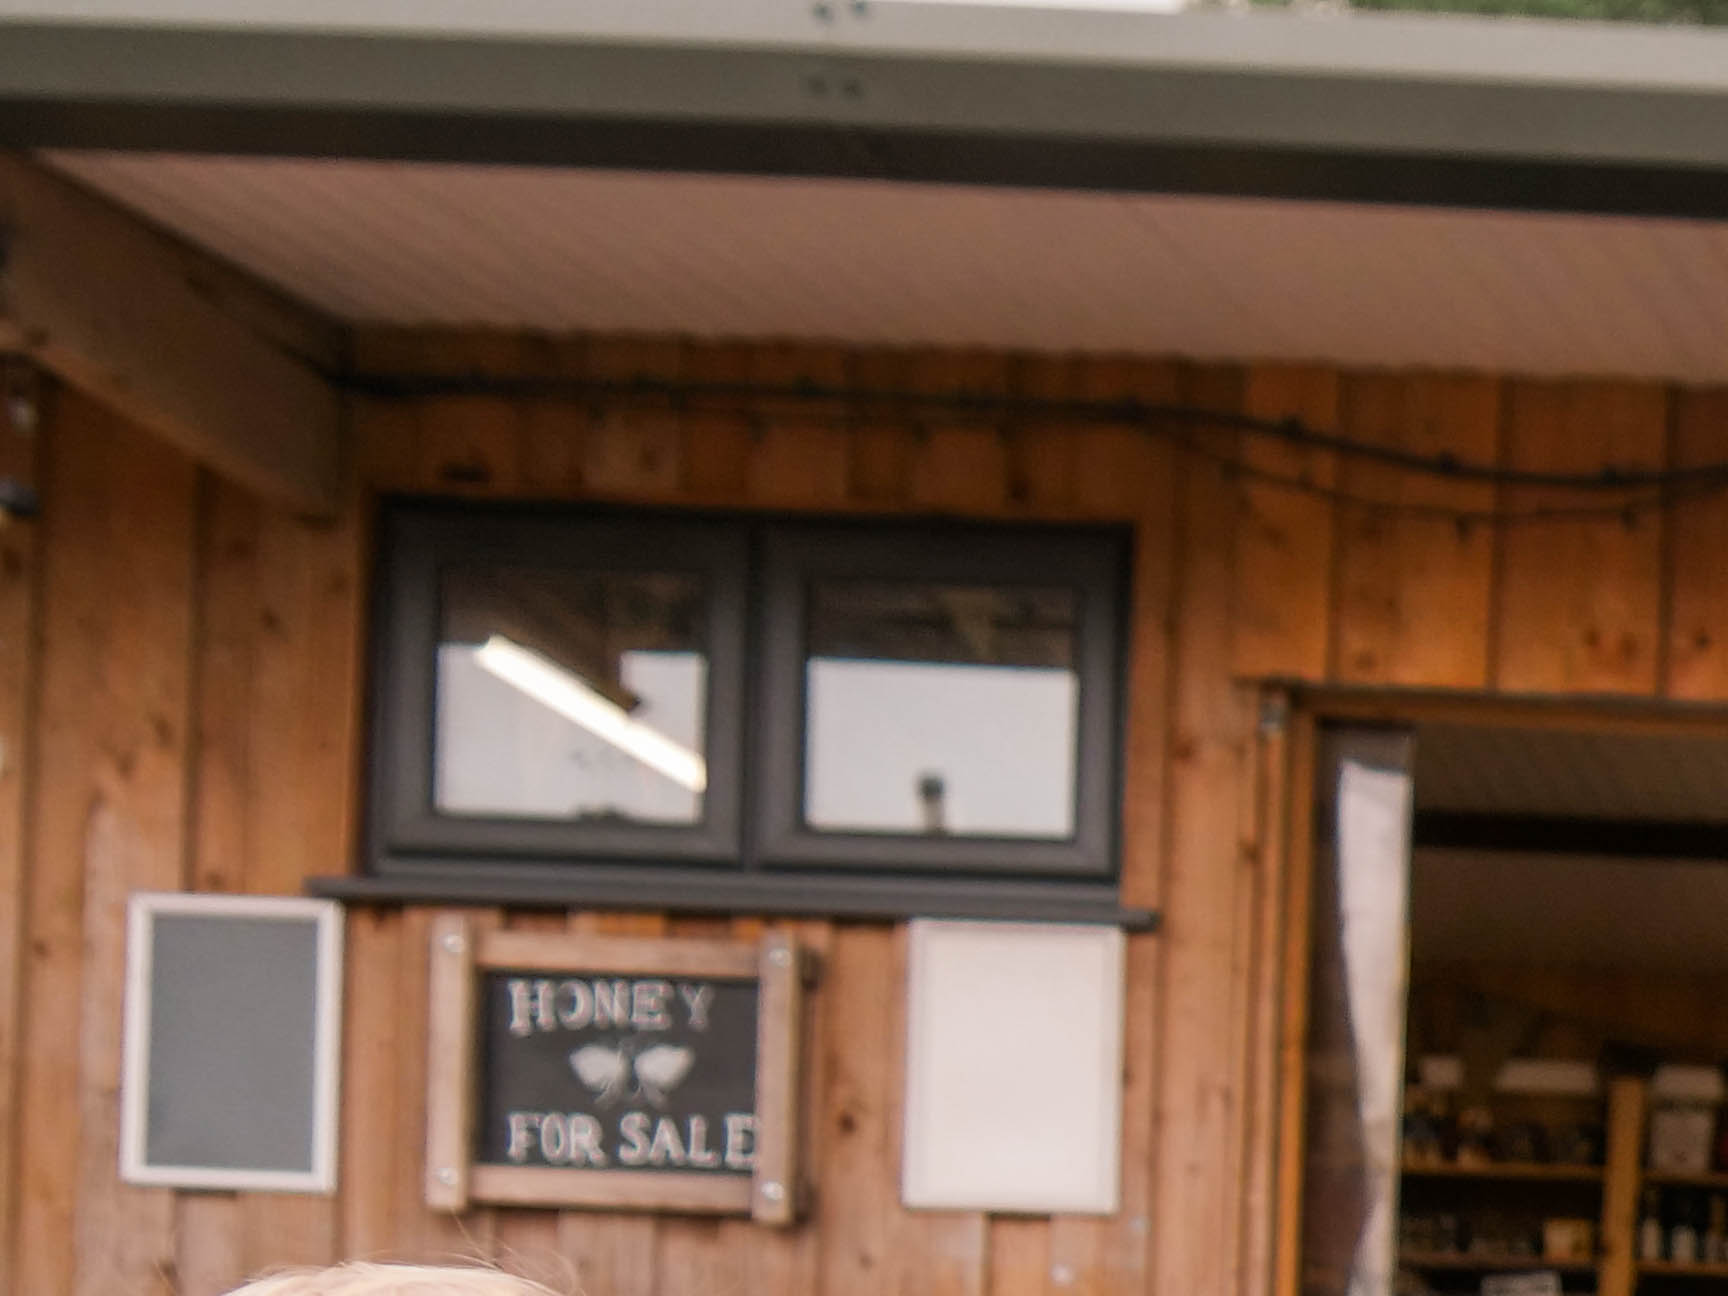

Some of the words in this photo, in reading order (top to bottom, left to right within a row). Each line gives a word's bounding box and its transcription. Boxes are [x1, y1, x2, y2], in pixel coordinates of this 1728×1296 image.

[508, 978, 715, 1037] HONEY
[507, 1111, 608, 1167] FOR
[617, 1111, 760, 1170] SALE
